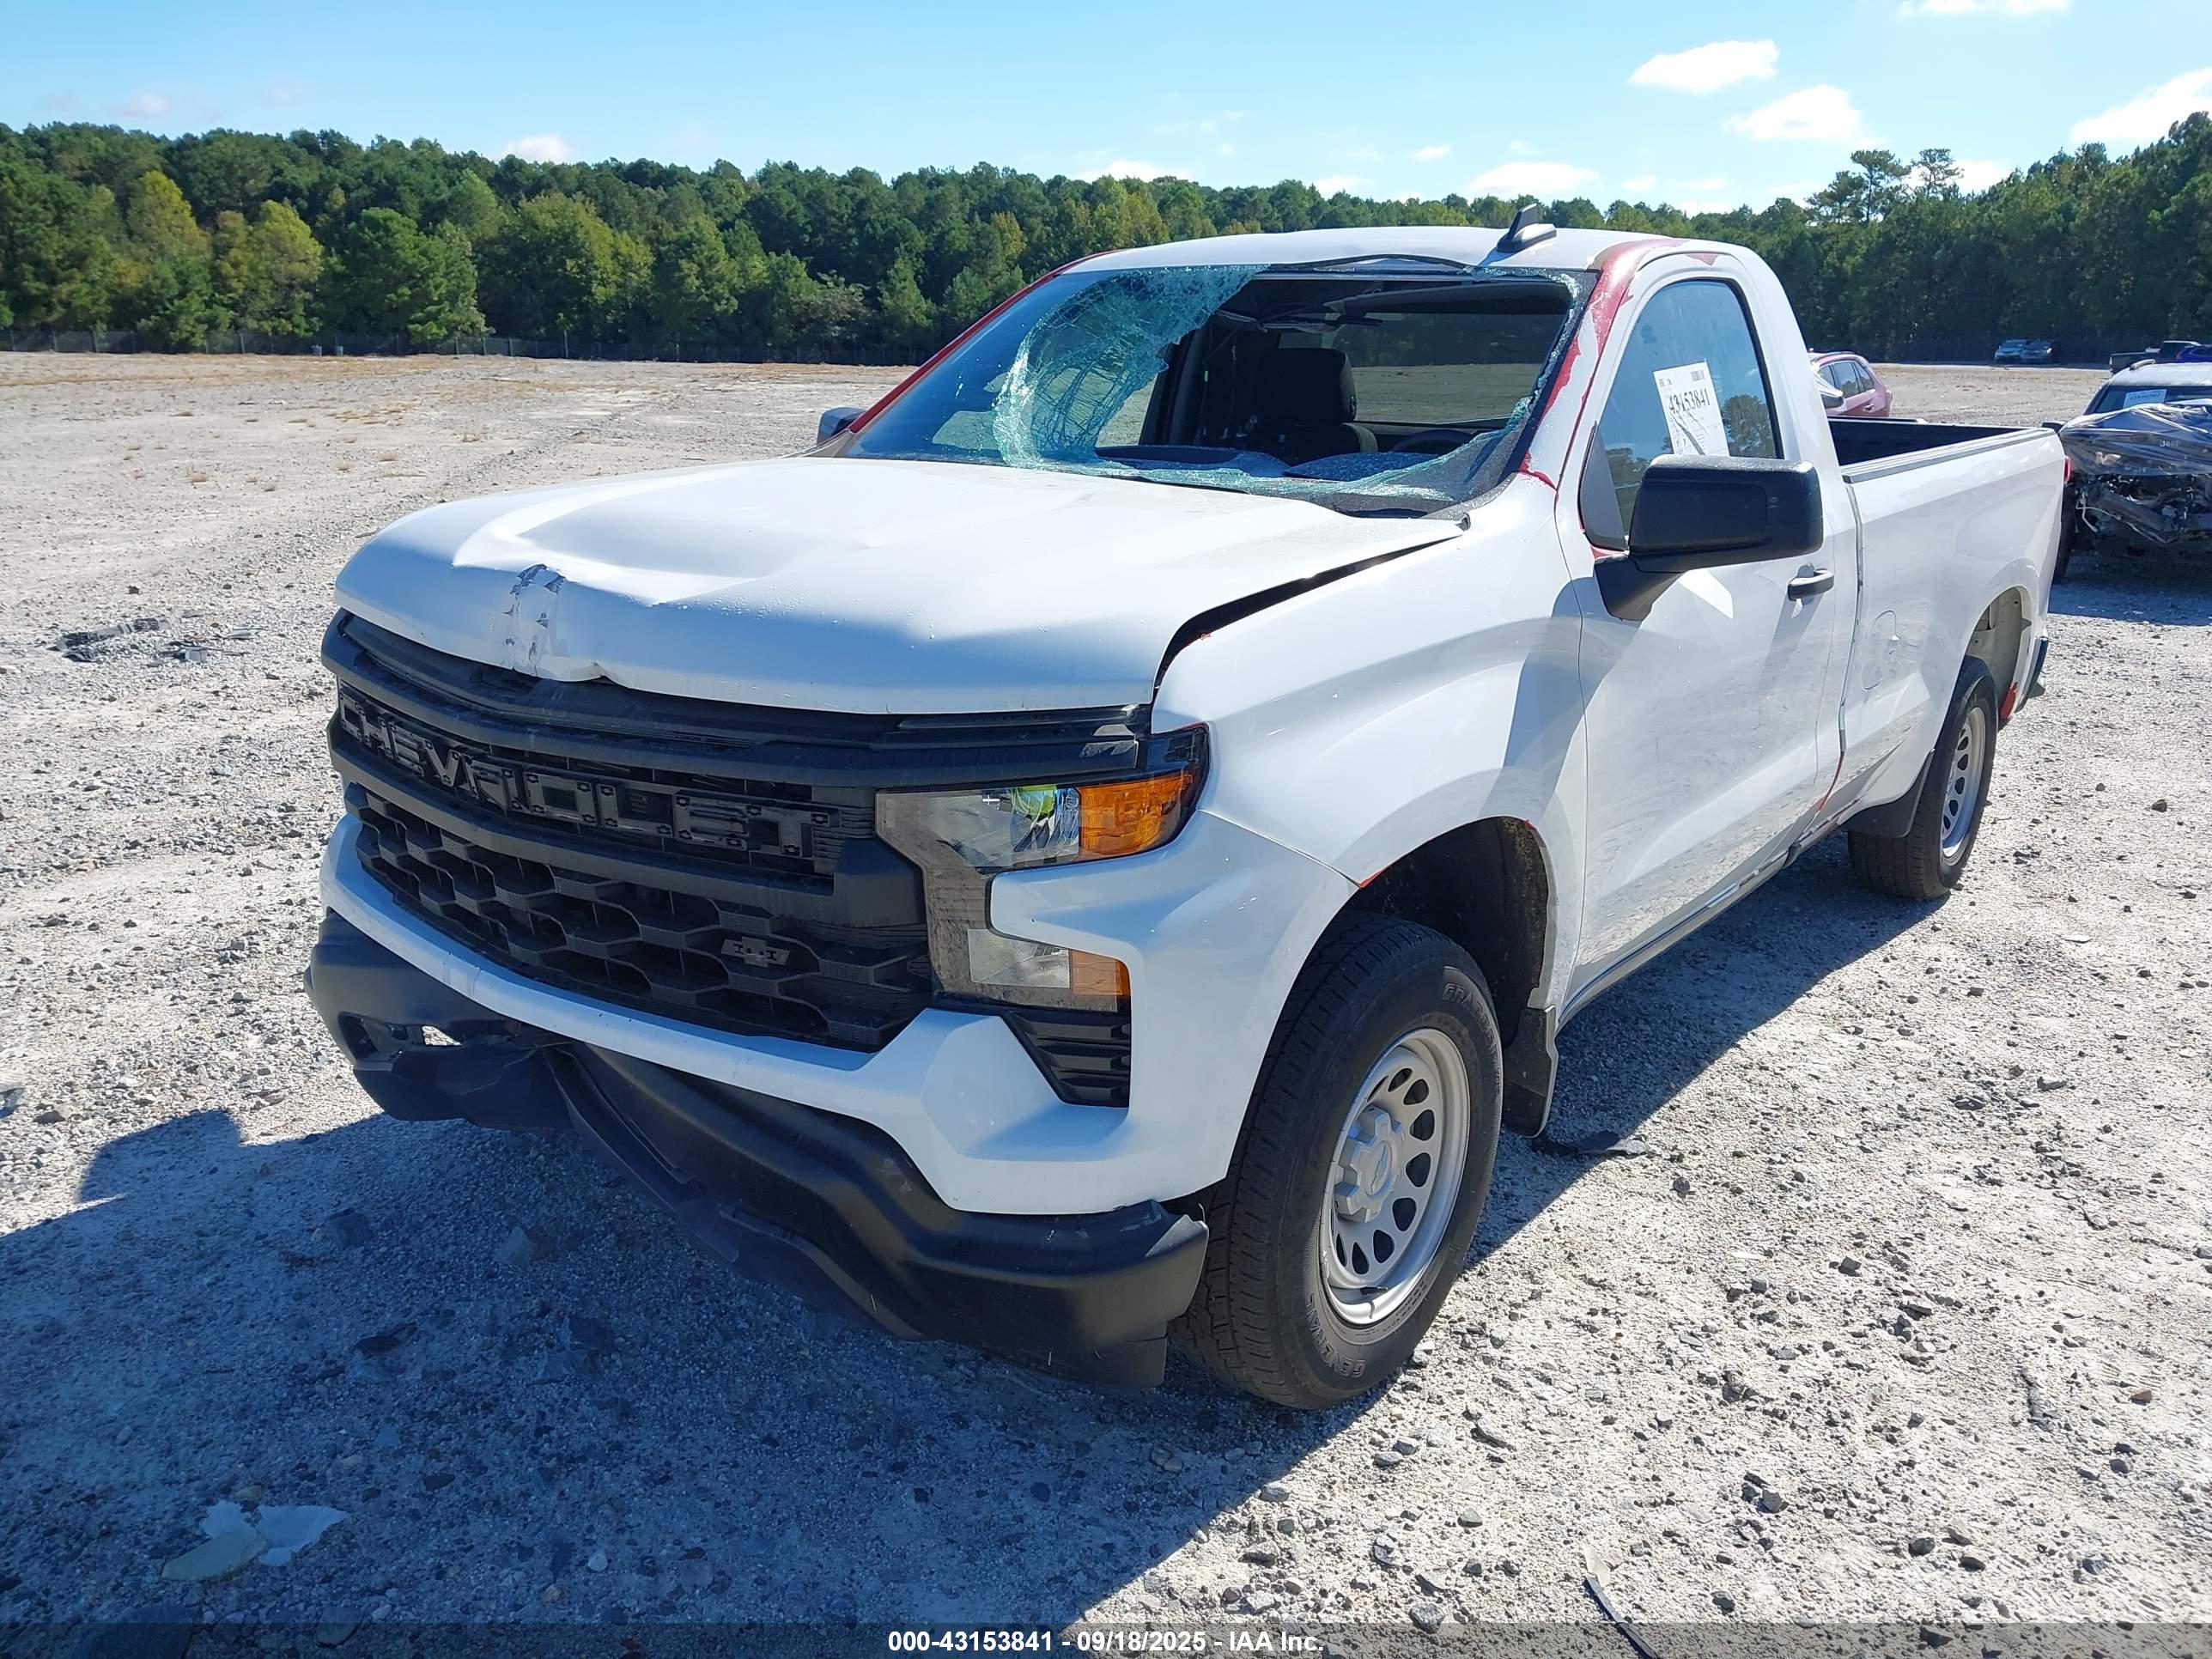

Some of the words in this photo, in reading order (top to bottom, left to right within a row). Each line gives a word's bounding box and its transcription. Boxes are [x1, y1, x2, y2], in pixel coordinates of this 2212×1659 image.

[1668, 387, 1711, 414] 43153841
[338, 691, 836, 858] CHEVROLET
[1305, 1291, 1366, 1378] GENERAL
